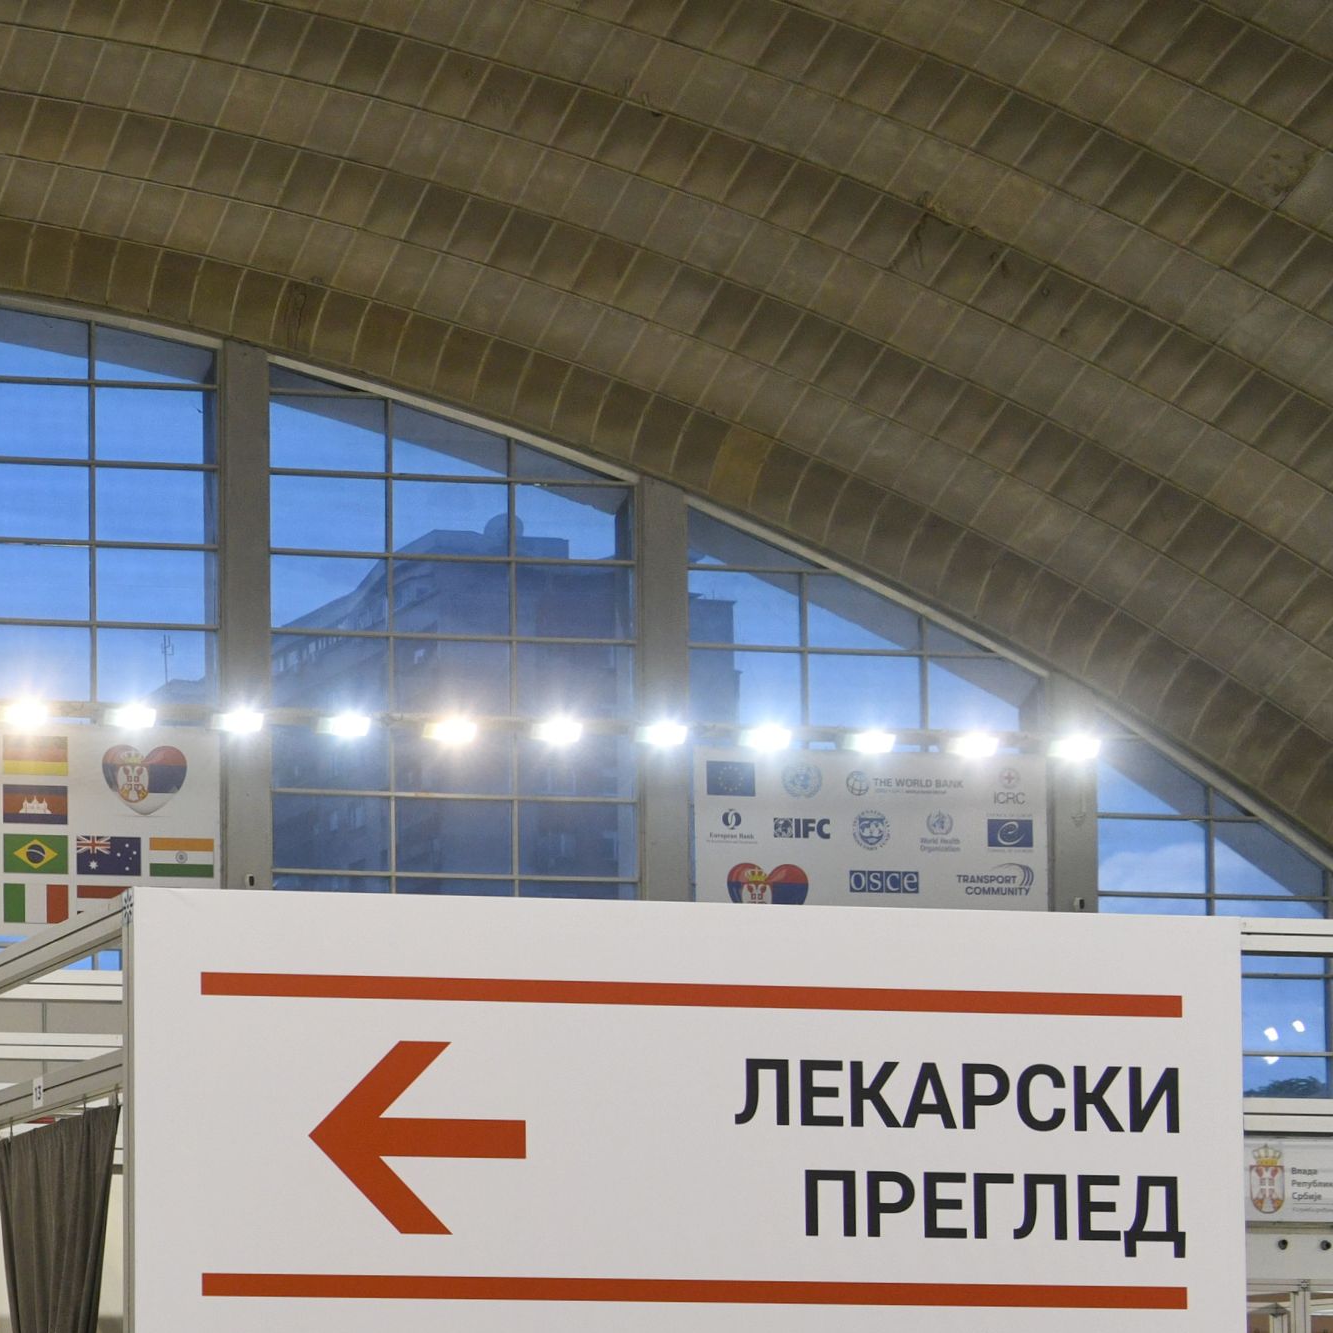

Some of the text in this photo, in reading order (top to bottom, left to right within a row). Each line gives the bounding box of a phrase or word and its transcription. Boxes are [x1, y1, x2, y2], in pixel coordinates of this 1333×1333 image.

[993, 791, 1025, 805] ICRC
[794, 818, 831, 839] IFC
[957, 874, 1017, 884] TRANSPORT
[965, 886, 1030, 896] COMMUNITY
[735, 1058, 1180, 1133] ЛЕКАРСКИ
[1291, 1167, 1318, 1175] Влада
[805, 1169, 1186, 1258] ПРЕГЛЕД
